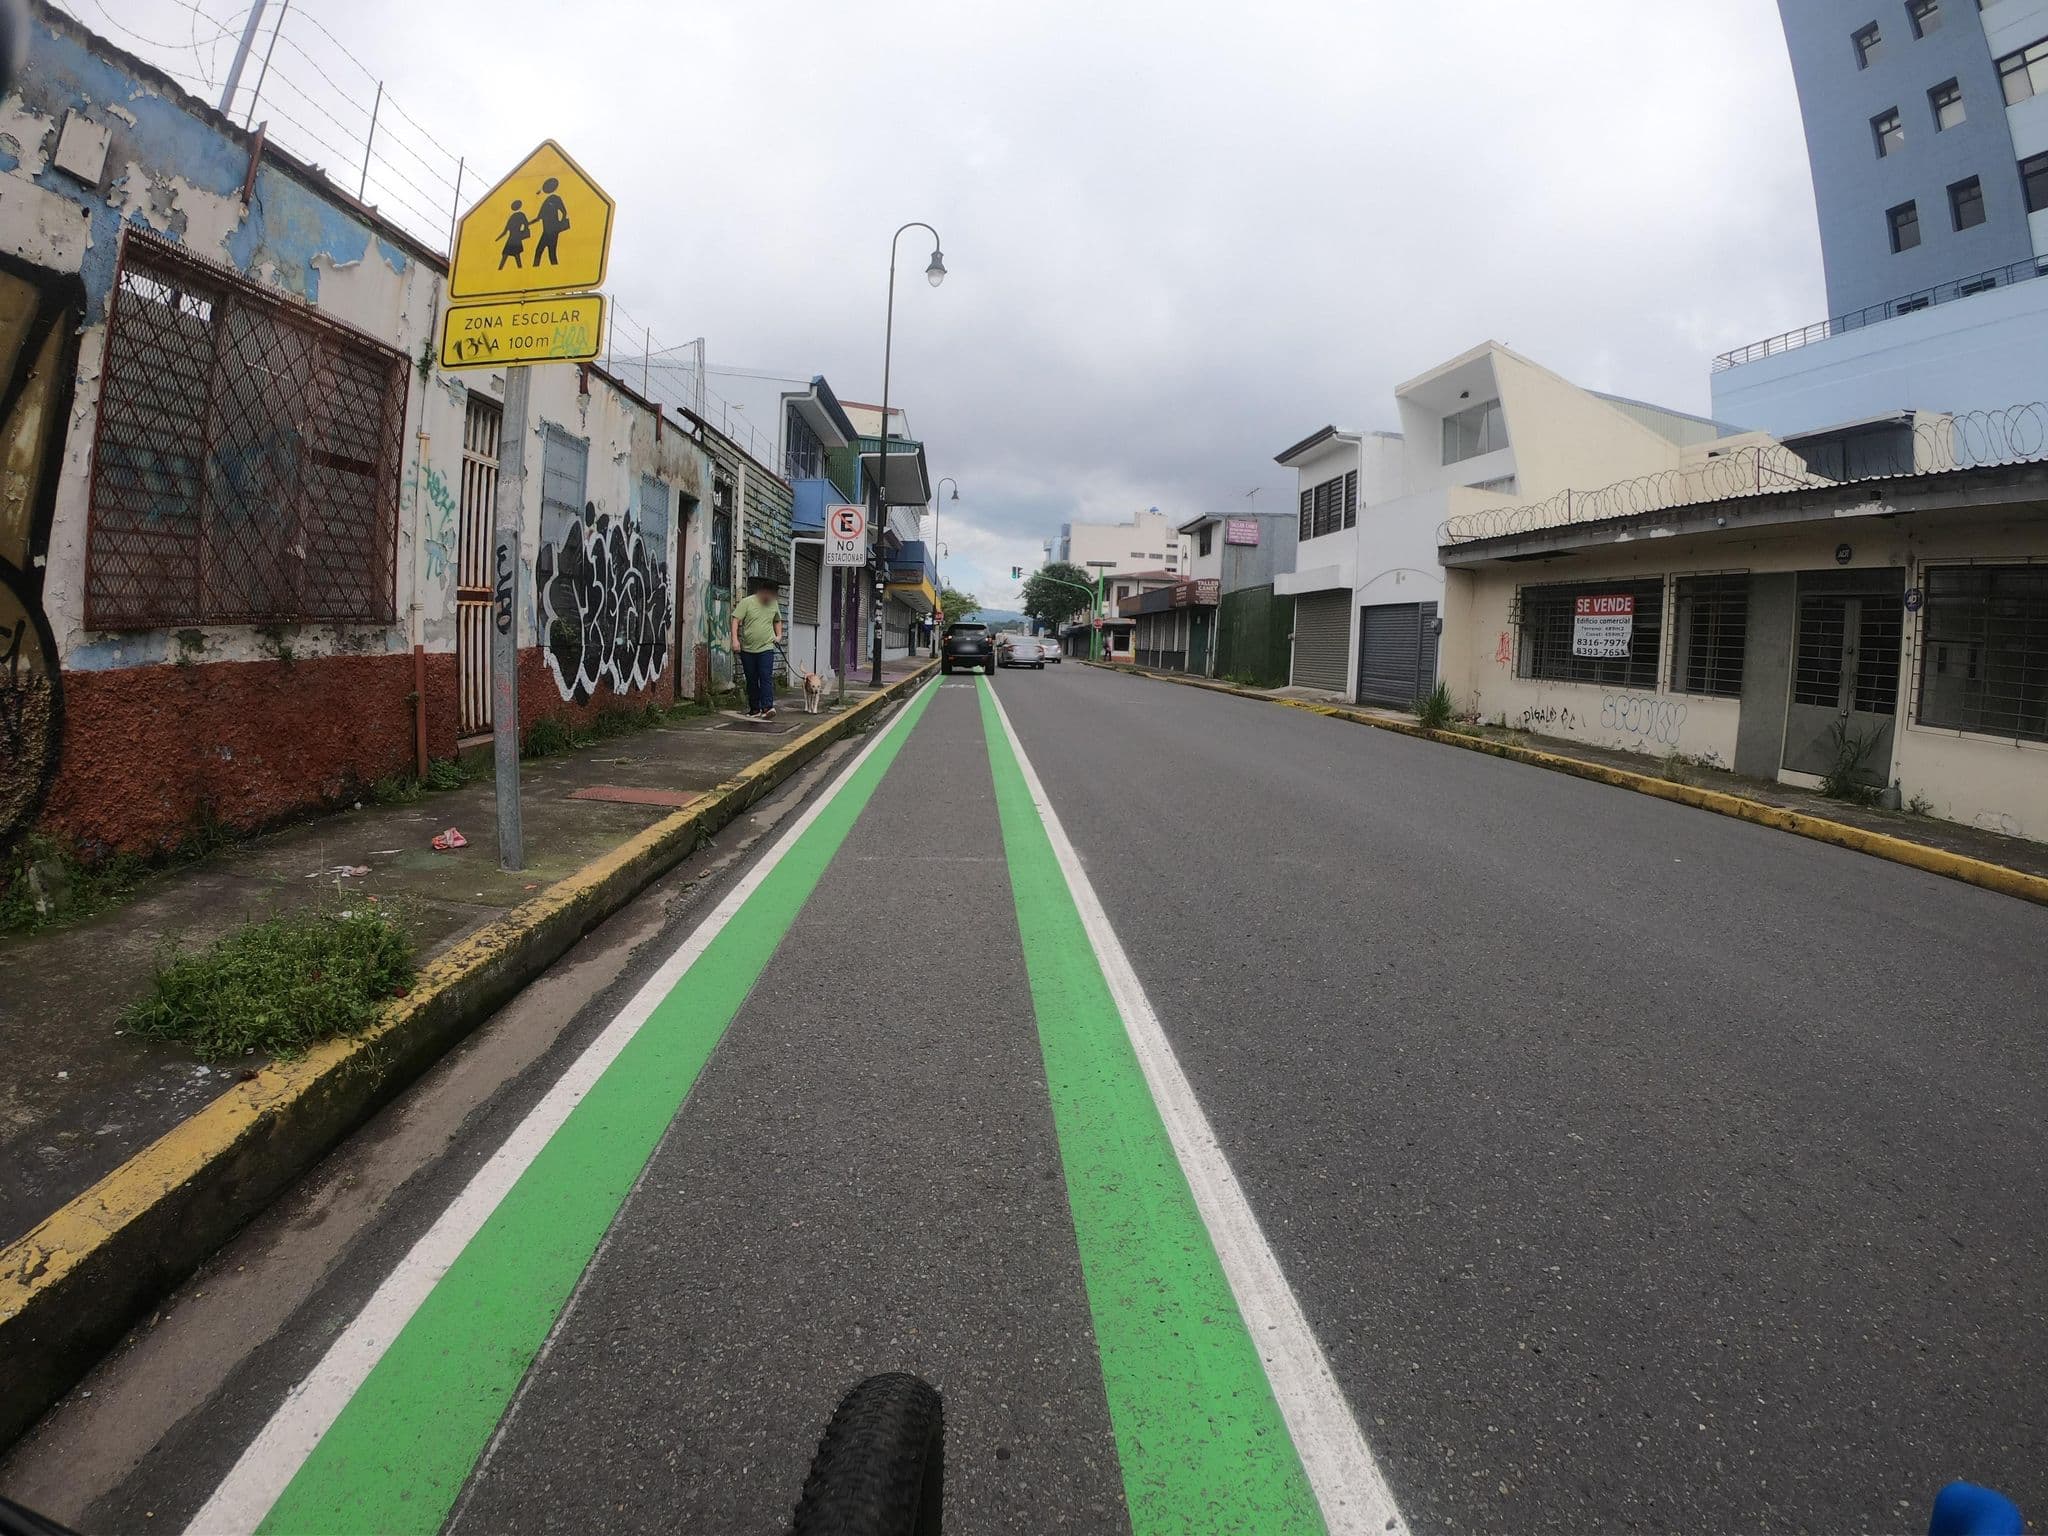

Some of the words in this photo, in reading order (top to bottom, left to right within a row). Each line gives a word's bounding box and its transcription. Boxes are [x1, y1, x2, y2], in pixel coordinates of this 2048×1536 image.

[464, 315, 503, 330] ZONA
[511, 310, 580, 326] ESCOLAR
[837, 540, 854, 551] NO
[828, 552, 863, 561] ESTACIONAR
[1577, 598, 1591, 613] SE
[1593, 597, 1632, 613] VENDE
[1599, 617, 1631, 625] comercial
